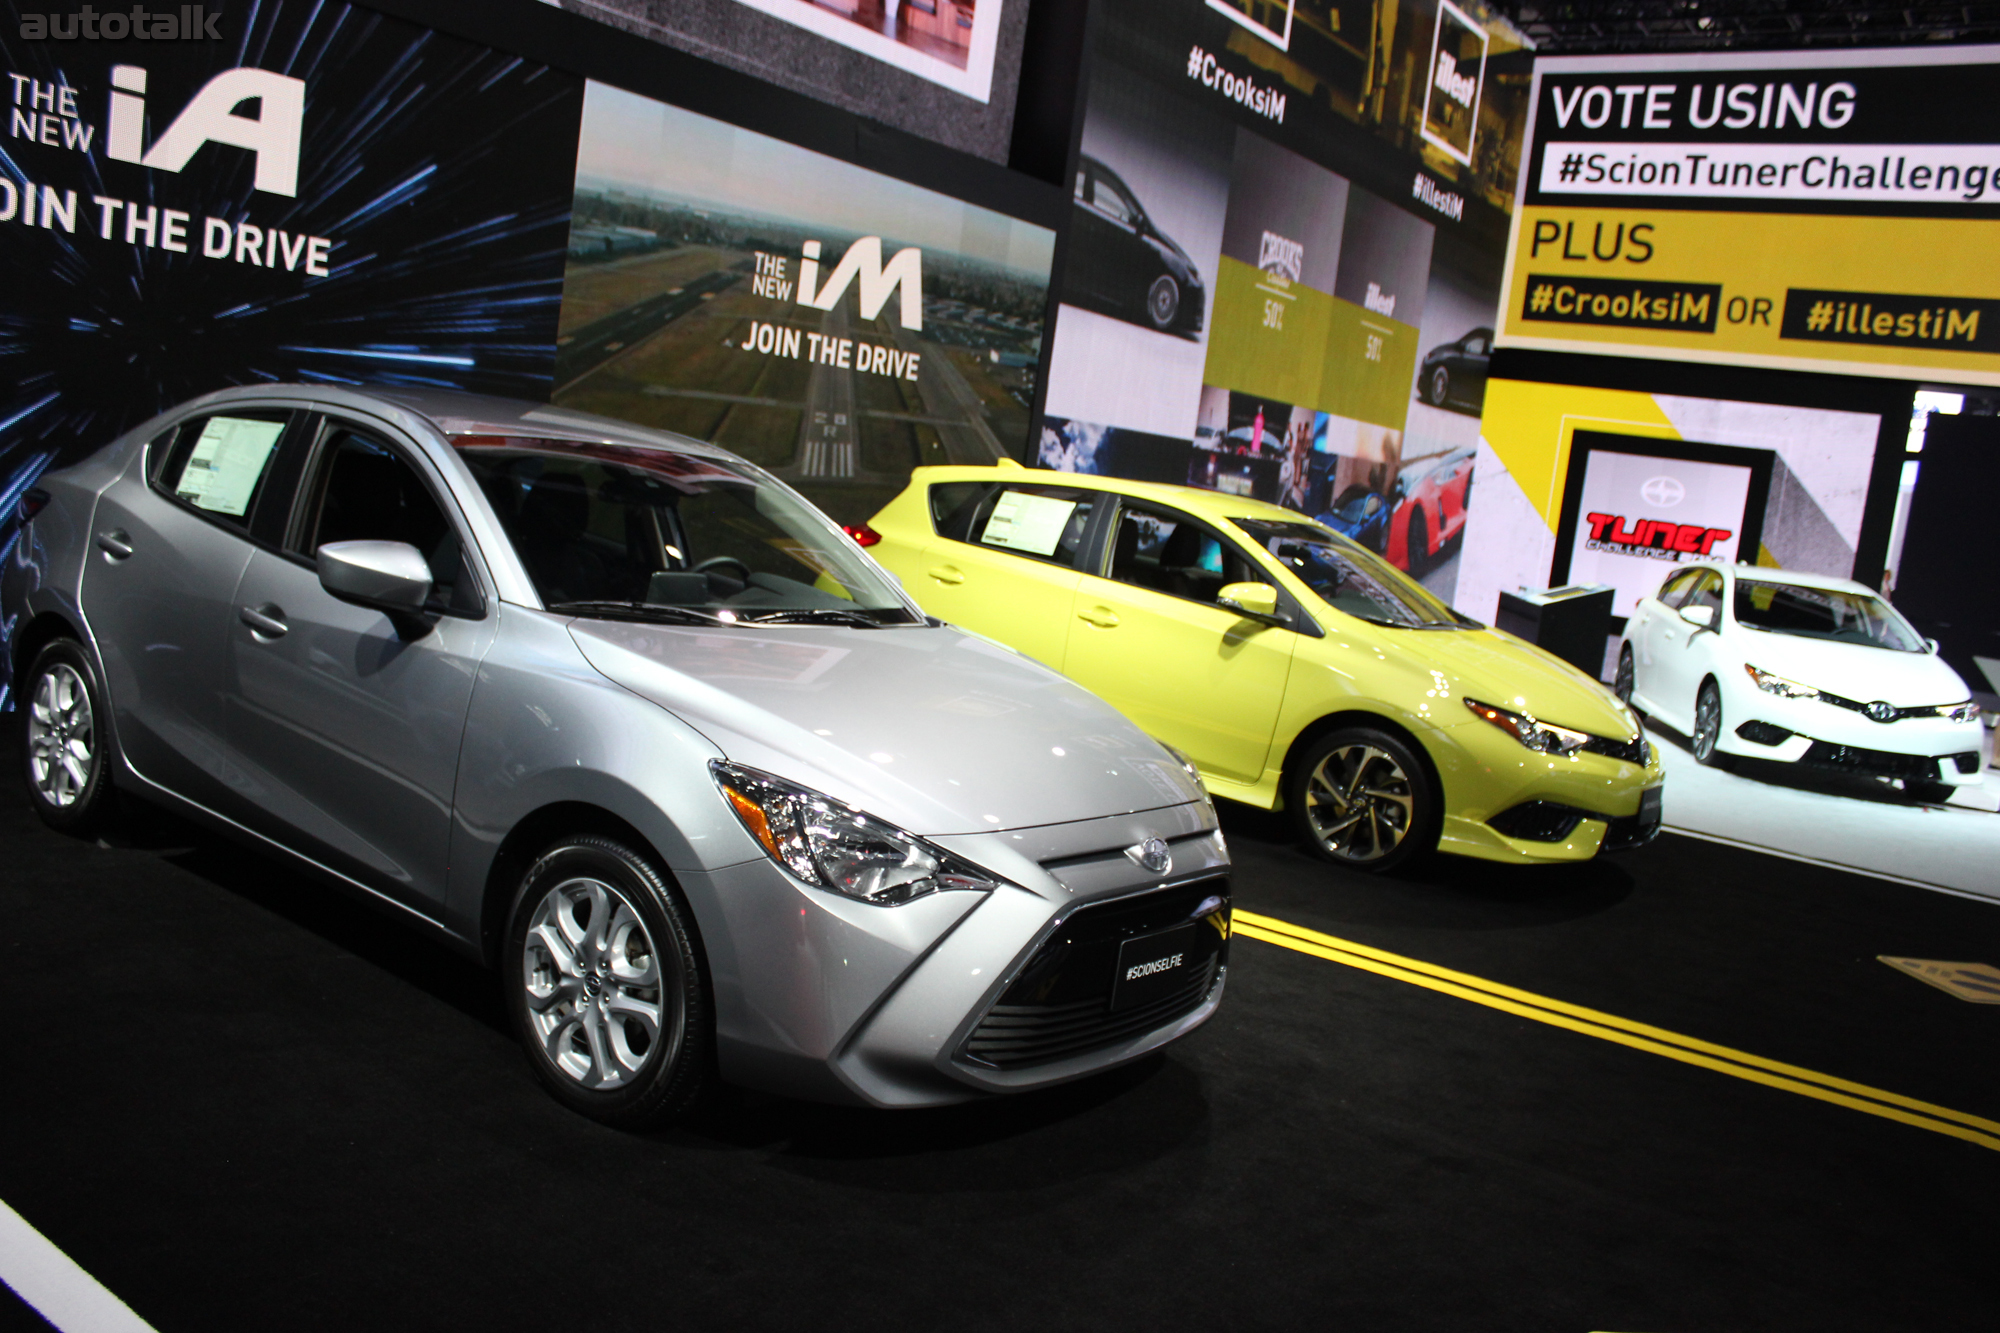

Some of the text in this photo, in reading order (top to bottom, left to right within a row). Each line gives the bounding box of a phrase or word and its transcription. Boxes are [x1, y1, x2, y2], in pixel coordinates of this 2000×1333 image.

[9, 72, 79, 118] THE
[1187, 45, 1286, 124] #CrooksiM
[1434, 50, 1476, 109] illest
[1552, 81, 1857, 129] VOTE USING
[9, 107, 95, 153] NEW
[107, 64, 306, 198] iA
[1412, 172, 1464, 222] #illestiM
[0, 176, 332, 278] OIN THE DRIVE
[1531, 219, 1655, 263] PLUS
[754, 251, 787, 279] THE
[1258, 230, 1304, 283] CROOKS
[752, 273, 793, 302] NEW
[796, 236, 922, 332] iM
[1263, 299, 1285, 331] 50%
[1530, 284, 1981, 342] #CrooksiM OR #illestiM
[741, 321, 921, 382] JOIN THE DRIVE
[1365, 334, 1384, 363] 50%
[1586, 539, 1676, 561] CHALLENGE
[1126, 953, 1184, 981] #SCIONSELFIE
